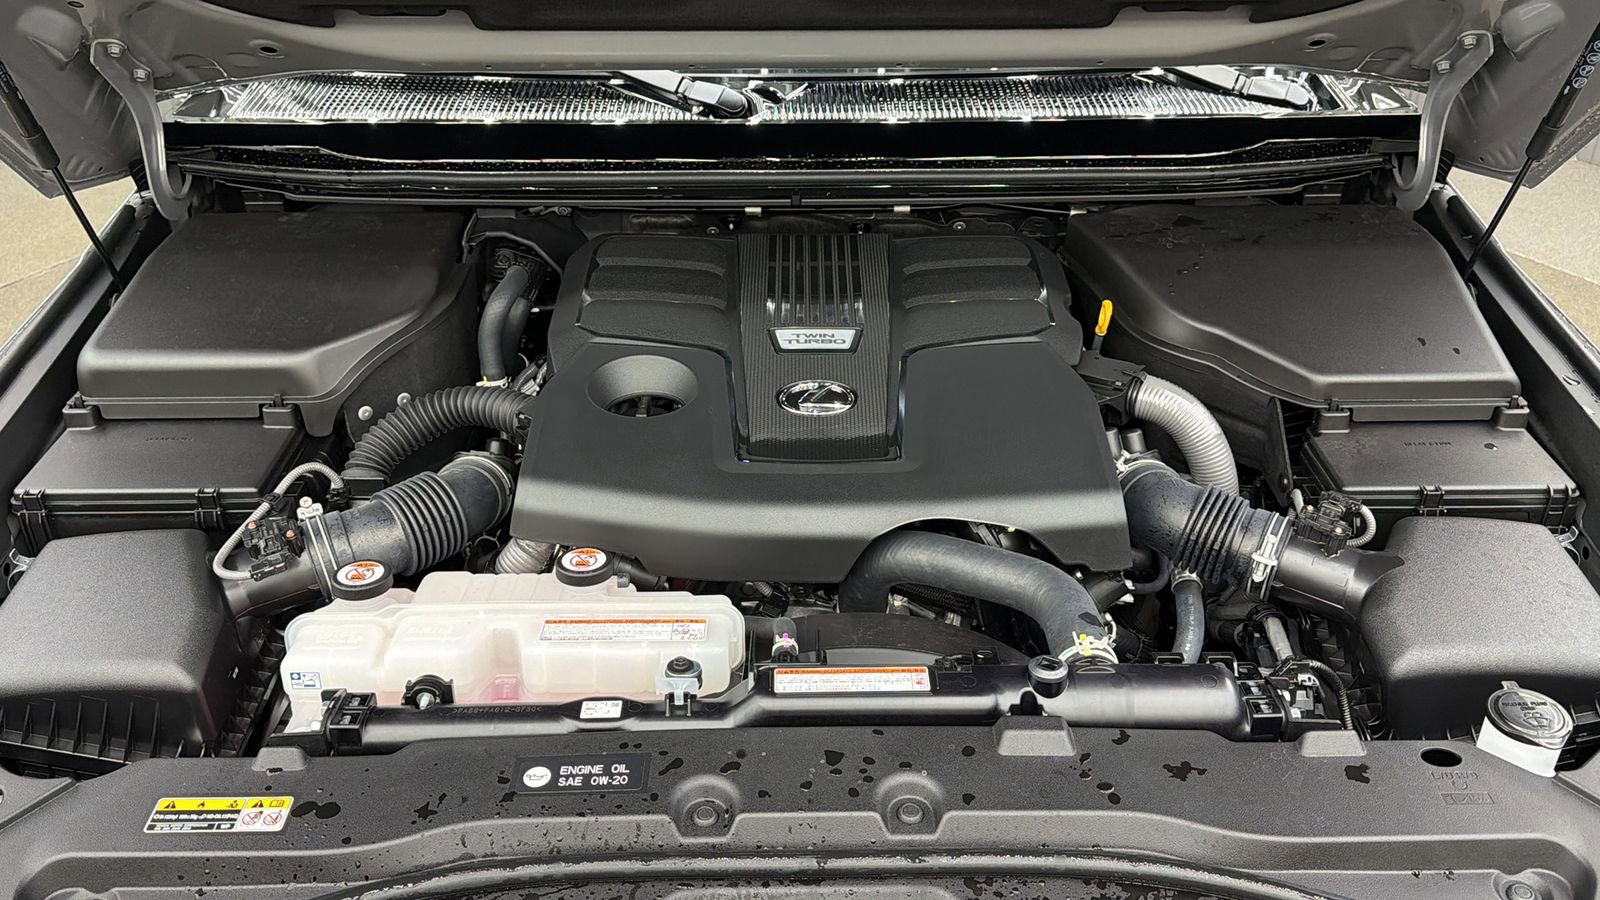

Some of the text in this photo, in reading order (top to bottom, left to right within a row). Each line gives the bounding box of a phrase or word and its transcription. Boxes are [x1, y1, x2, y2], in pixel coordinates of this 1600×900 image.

[560, 764, 630, 775] ENGINE OIL
[558, 775, 629, 787] SAE 0W-20
